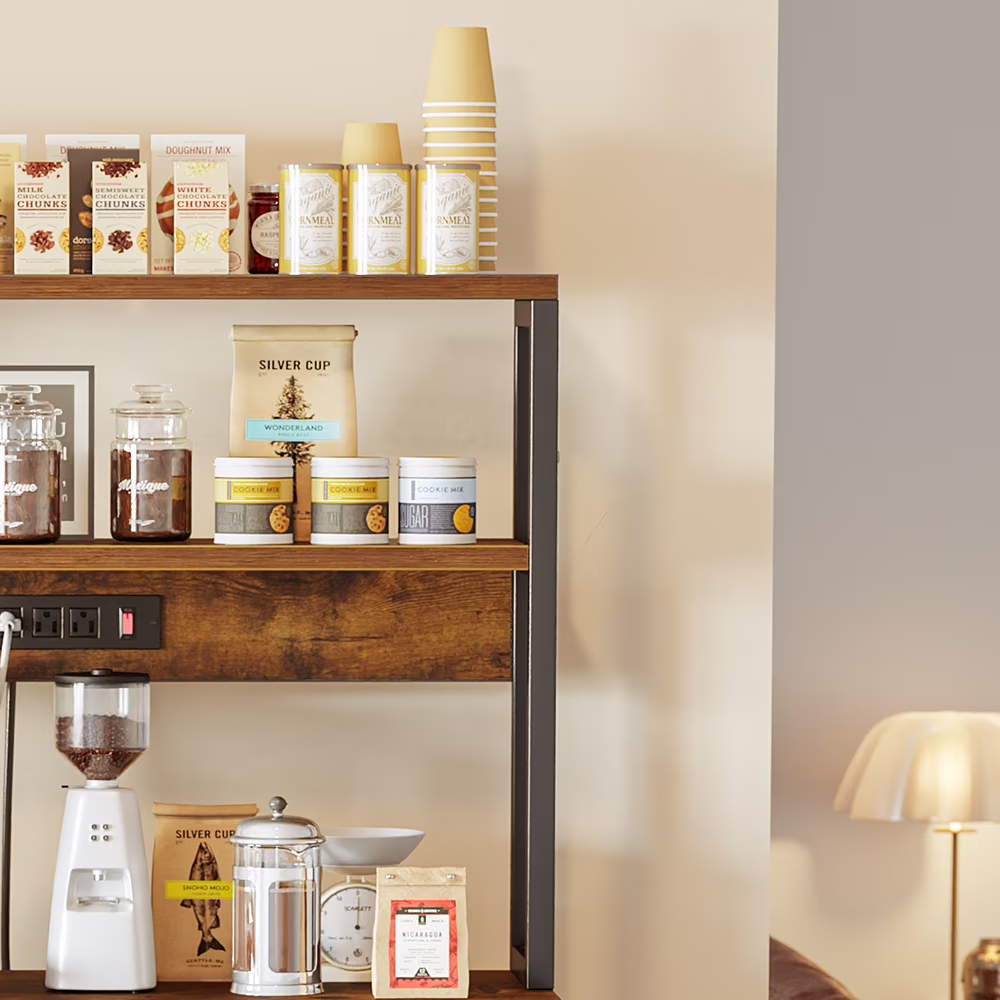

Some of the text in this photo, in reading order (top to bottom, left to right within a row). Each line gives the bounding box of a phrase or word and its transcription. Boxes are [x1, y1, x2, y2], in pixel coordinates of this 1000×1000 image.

[166, 146, 231, 155] DOUGHNUT MIX
[17, 200, 67, 208] CHUNKS
[96, 200, 145, 208] CHUNKS
[177, 200, 227, 208] CHUNKS
[259, 360, 331, 370] SILVER CUP
[176, 830, 211, 839] SILVER
